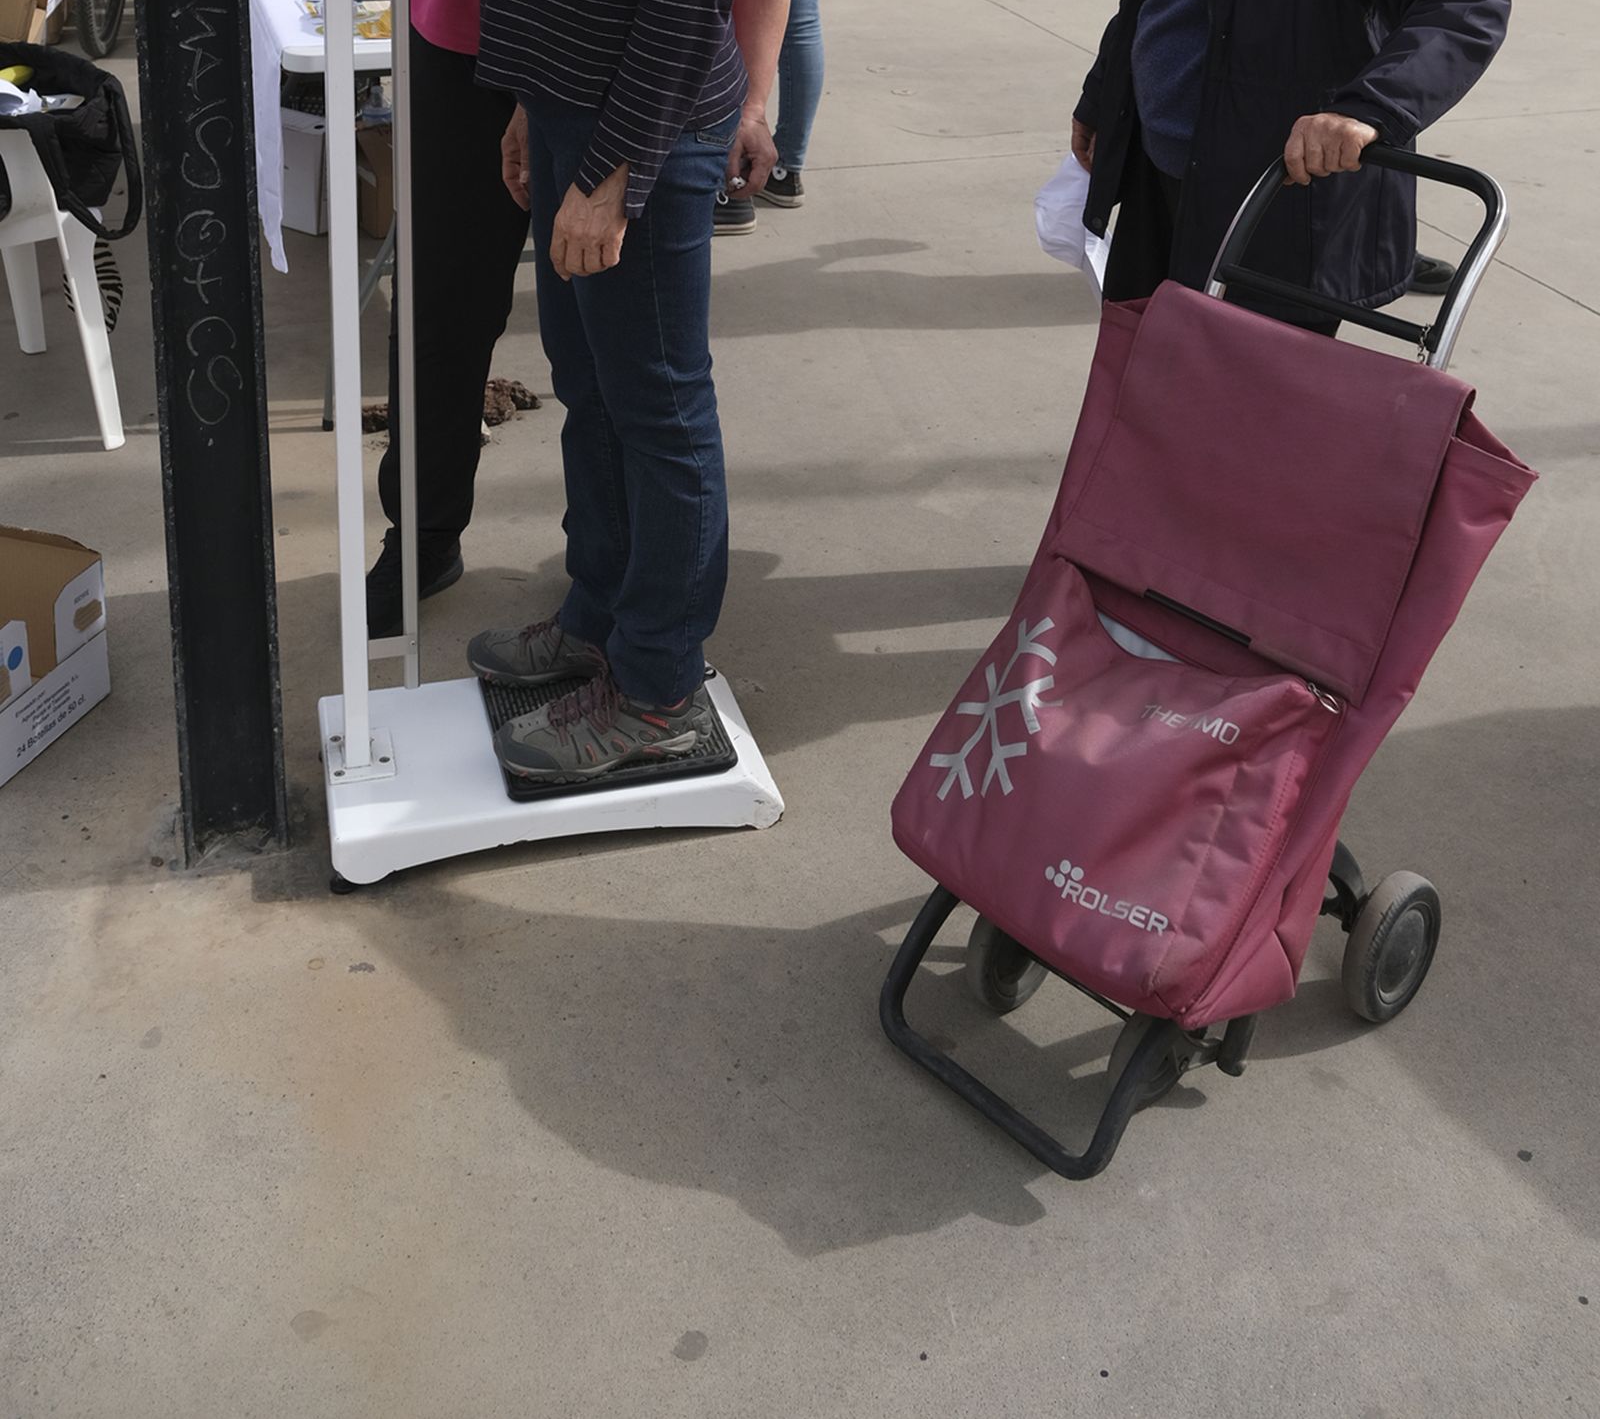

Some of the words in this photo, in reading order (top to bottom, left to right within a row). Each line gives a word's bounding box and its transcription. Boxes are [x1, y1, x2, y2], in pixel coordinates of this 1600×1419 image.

[16, 744, 27, 758] 24
[27, 719, 57, 749] Botellas
[57, 710, 68, 723] de
[1140, 703, 1241, 746] THEMO
[1061, 878, 1170, 937] ROLSER
